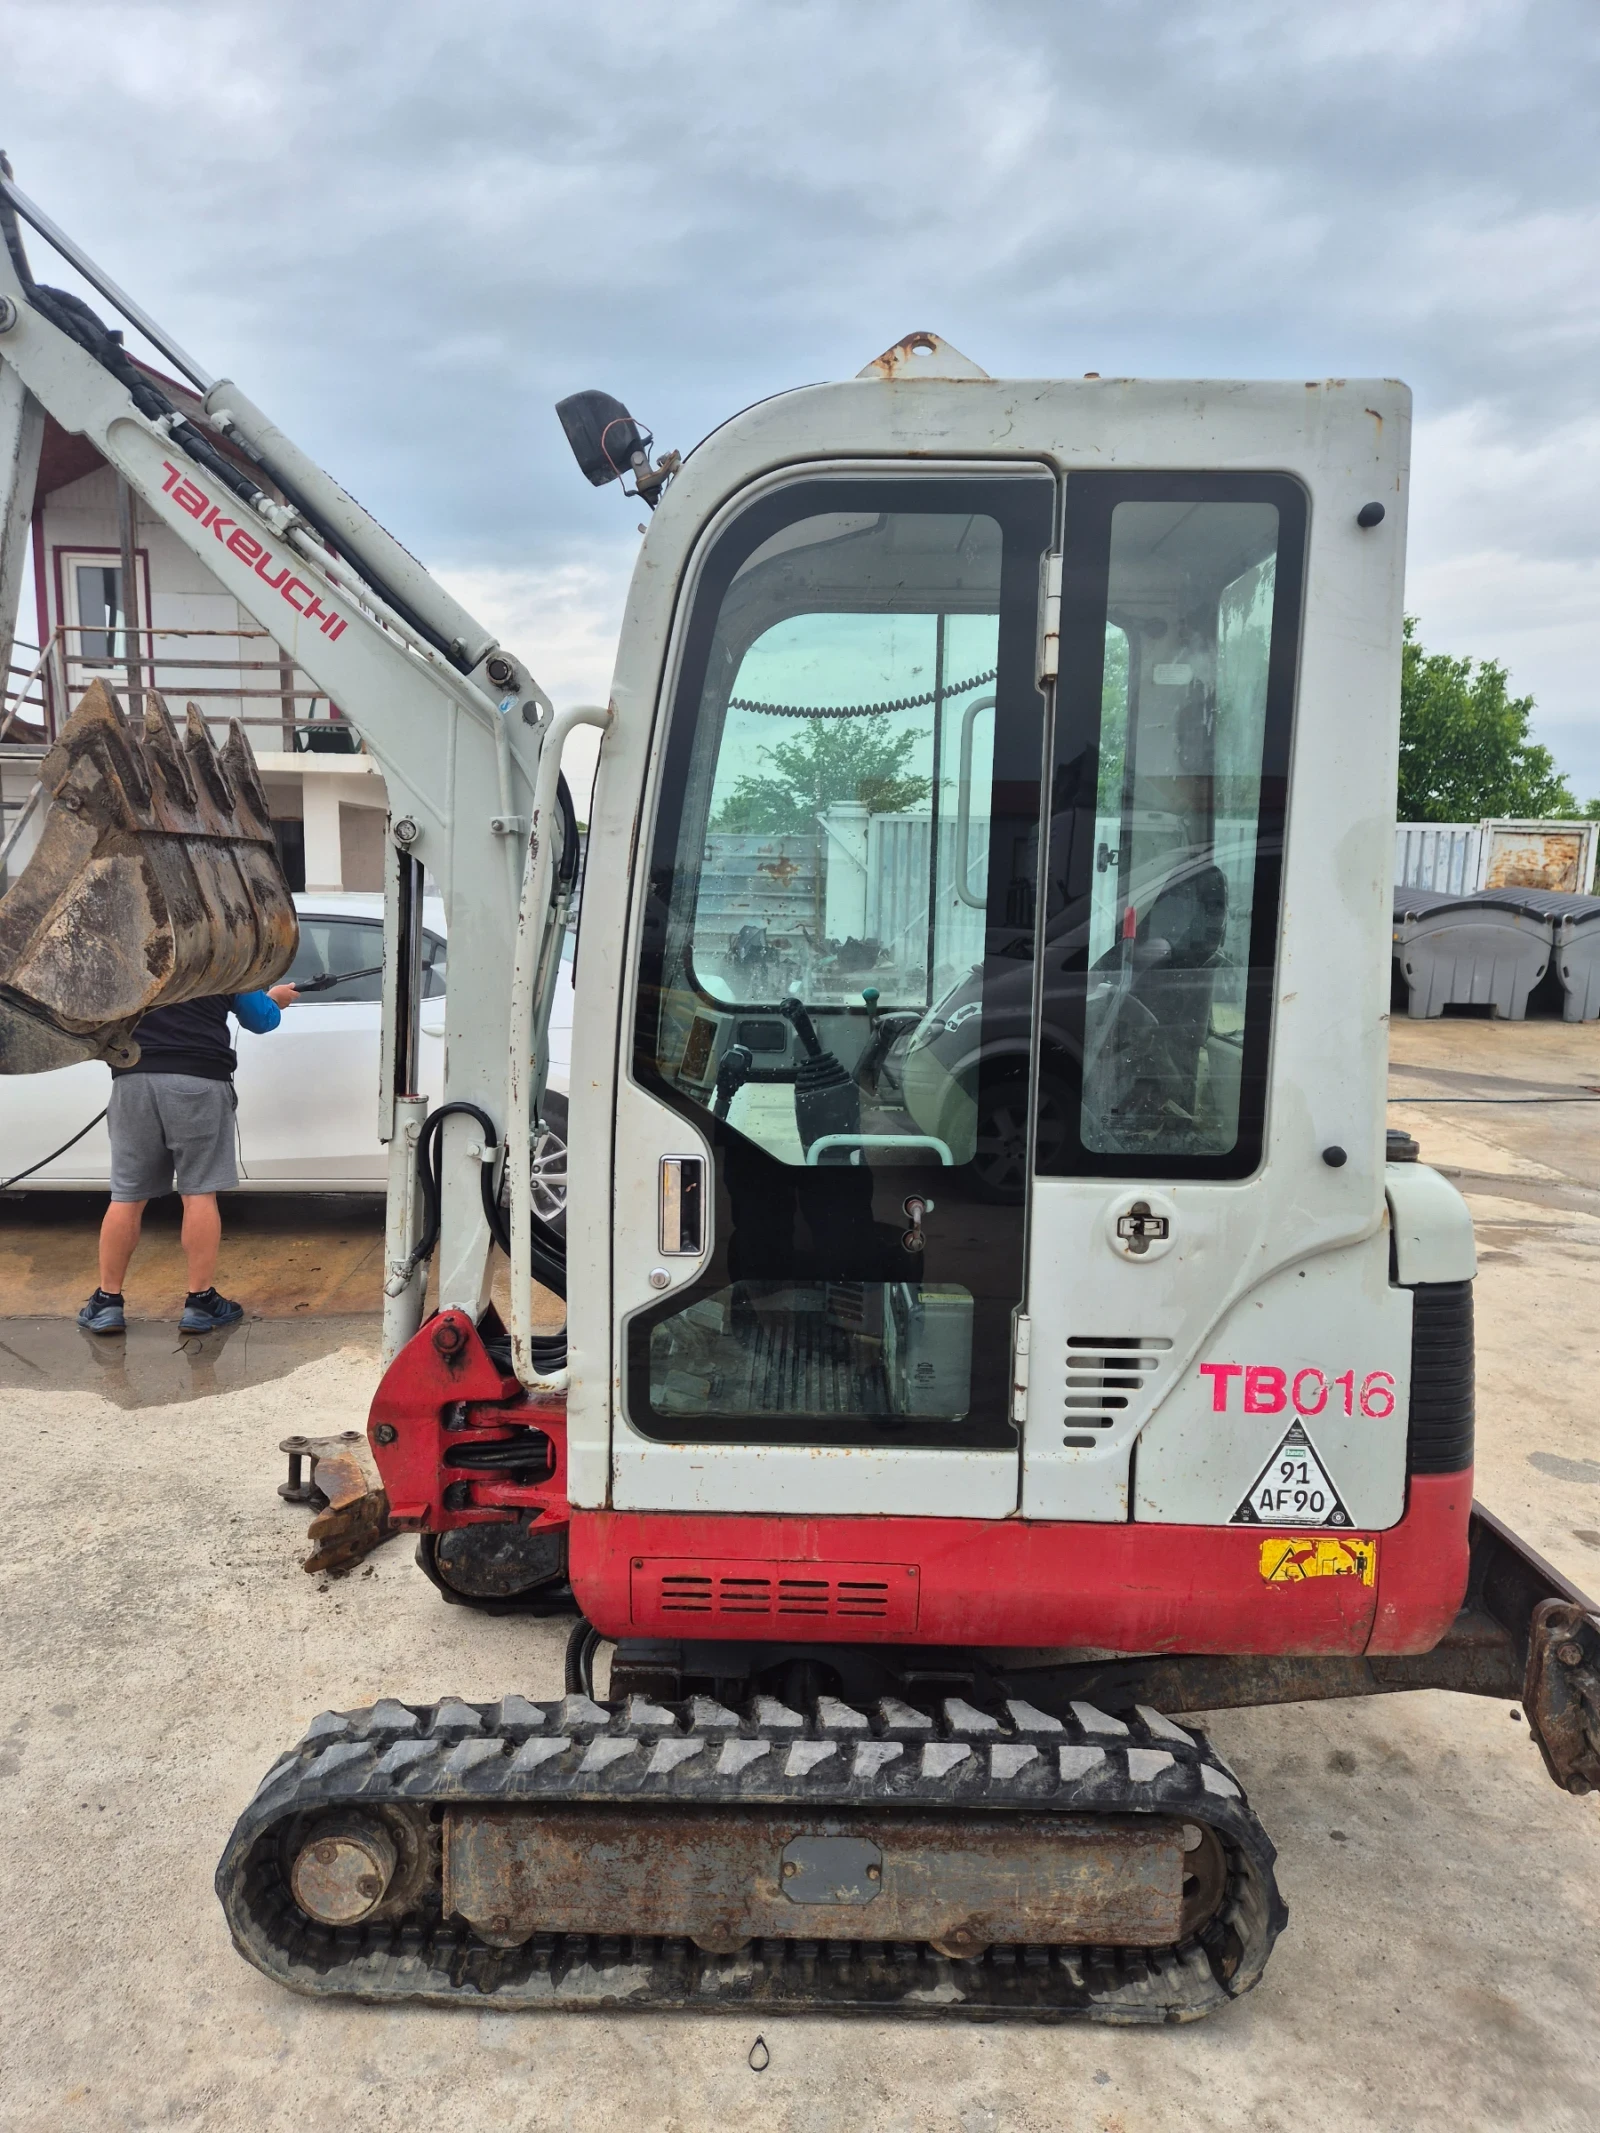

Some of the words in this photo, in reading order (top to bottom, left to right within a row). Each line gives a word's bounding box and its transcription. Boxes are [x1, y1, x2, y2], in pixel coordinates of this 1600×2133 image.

[1200, 1363, 1397, 1418] TB016
[1280, 1461, 1310, 1485] 91
[1259, 1488, 1325, 1513] AF90
